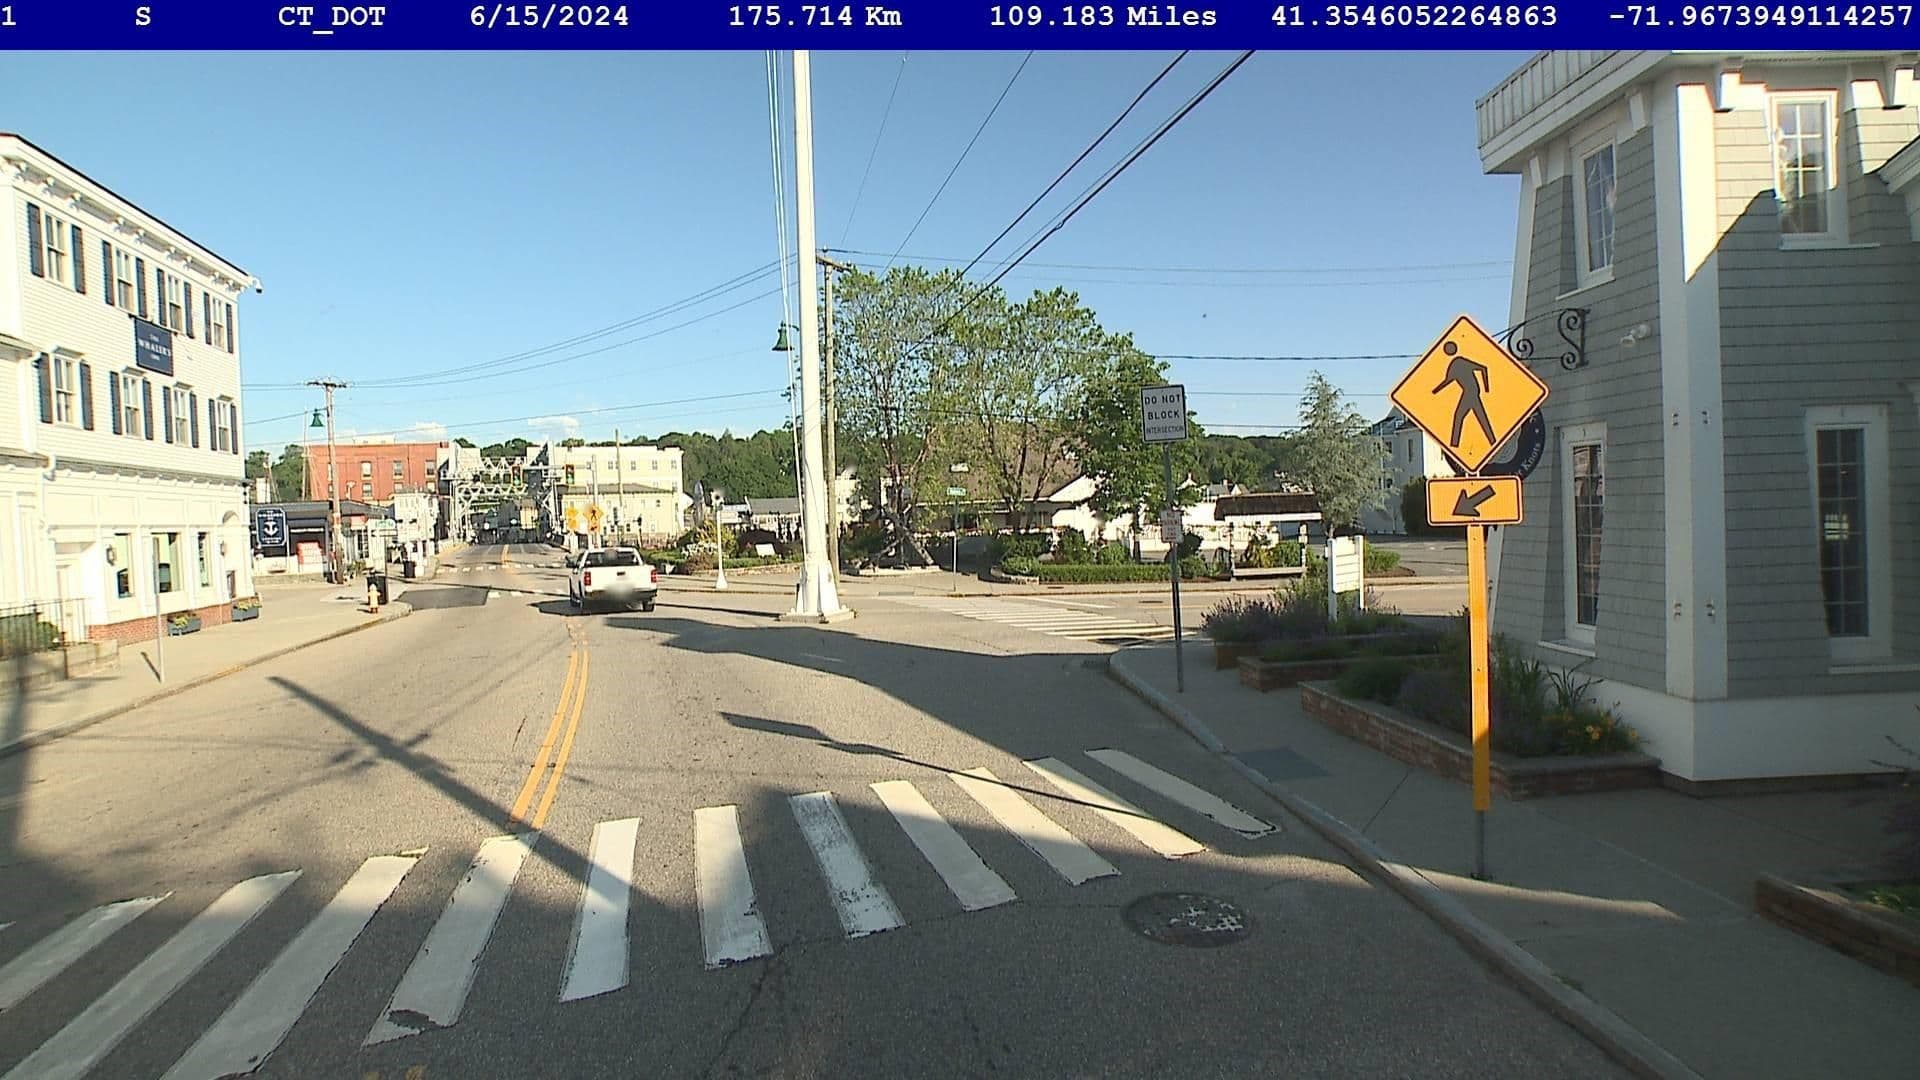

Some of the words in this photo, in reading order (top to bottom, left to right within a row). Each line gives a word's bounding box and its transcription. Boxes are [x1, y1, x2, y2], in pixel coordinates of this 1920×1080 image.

[1144, 396, 1157, 405] DO
[1162, 394, 1180, 404] NOT
[1147, 410, 1180, 421] BLOCK
